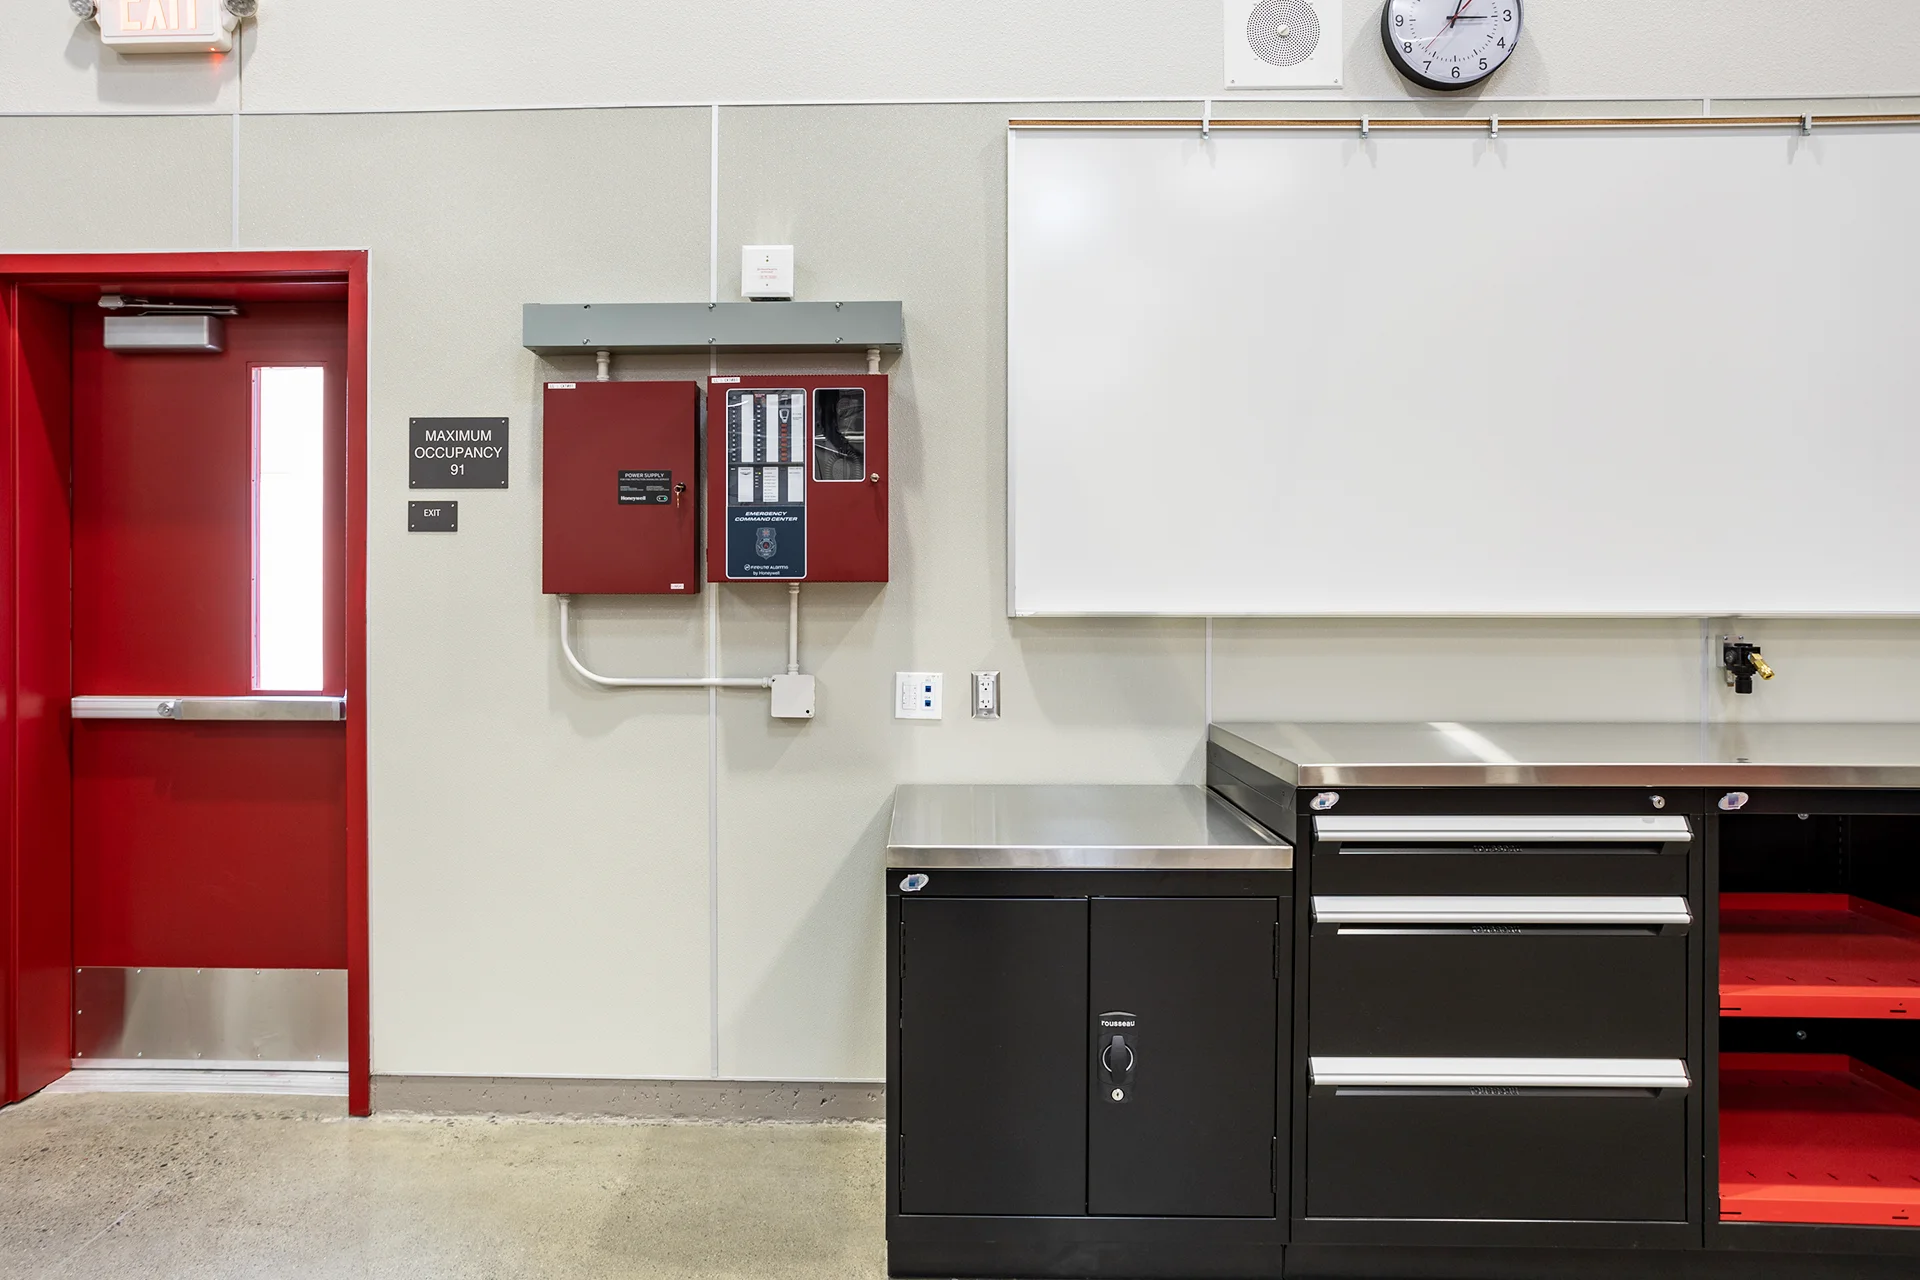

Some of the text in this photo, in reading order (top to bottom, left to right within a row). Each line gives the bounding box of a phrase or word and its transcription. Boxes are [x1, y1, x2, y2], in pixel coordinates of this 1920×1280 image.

[1395, 14, 1404, 27] 9
[1502, 9, 1512, 22] 3
[1403, 41, 1413, 54] 8
[1496, 36, 1506, 49] 4
[1423, 60, 1432, 74] 7
[1478, 57, 1488, 71] 5
[1451, 66, 1461, 79] 6
[425, 429, 492, 442] MAXIMUM
[414, 446, 503, 459] OCCUPANCY
[450, 463, 465, 476] 91
[423, 508, 441, 517] EXIT
